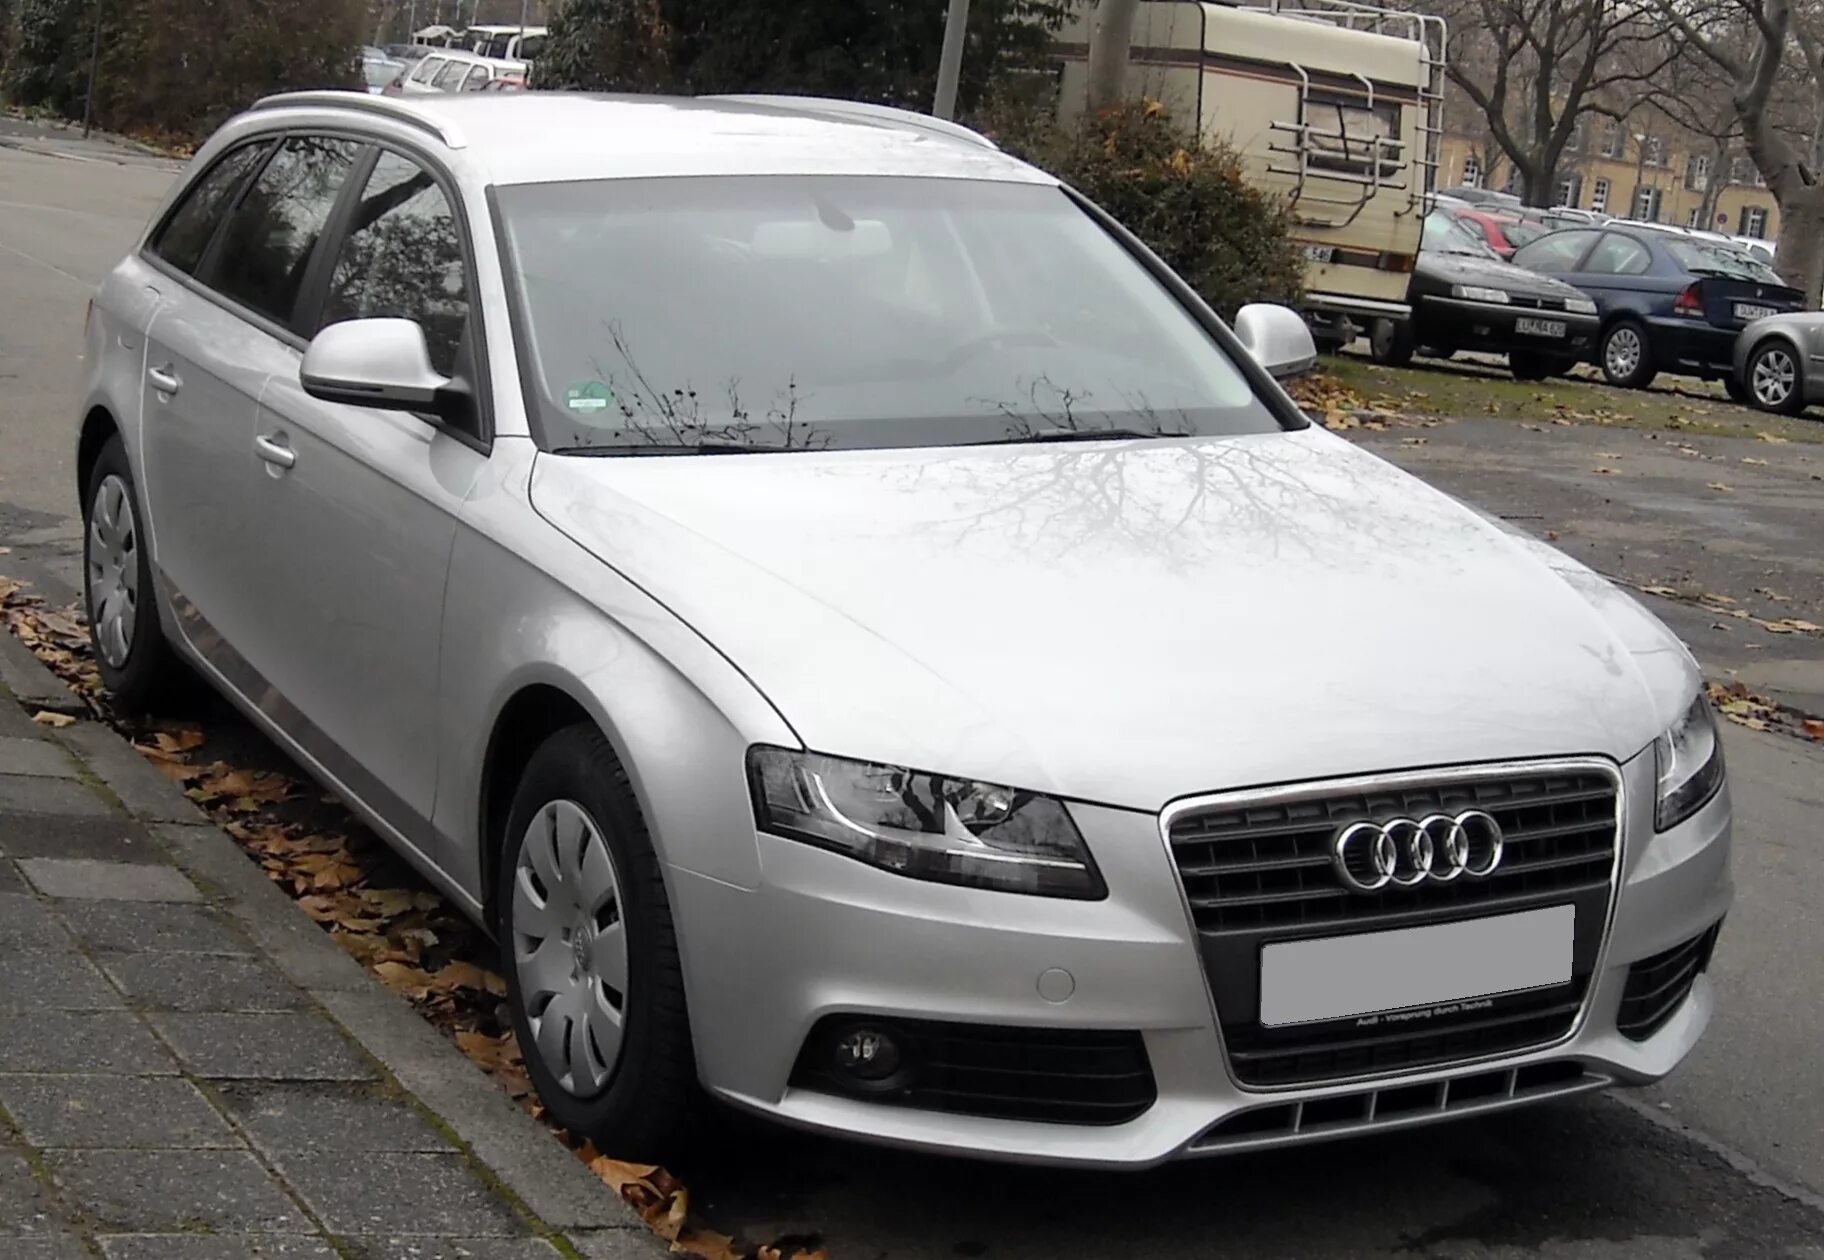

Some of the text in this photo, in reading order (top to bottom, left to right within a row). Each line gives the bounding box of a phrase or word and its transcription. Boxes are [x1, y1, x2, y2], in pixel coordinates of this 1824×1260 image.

[1356, 1016, 1378, 1027] Audi
[1385, 1009, 1432, 1021] Vorsprung
[1433, 1004, 1460, 1015] durch
[1460, 999, 1493, 1011] Technik
